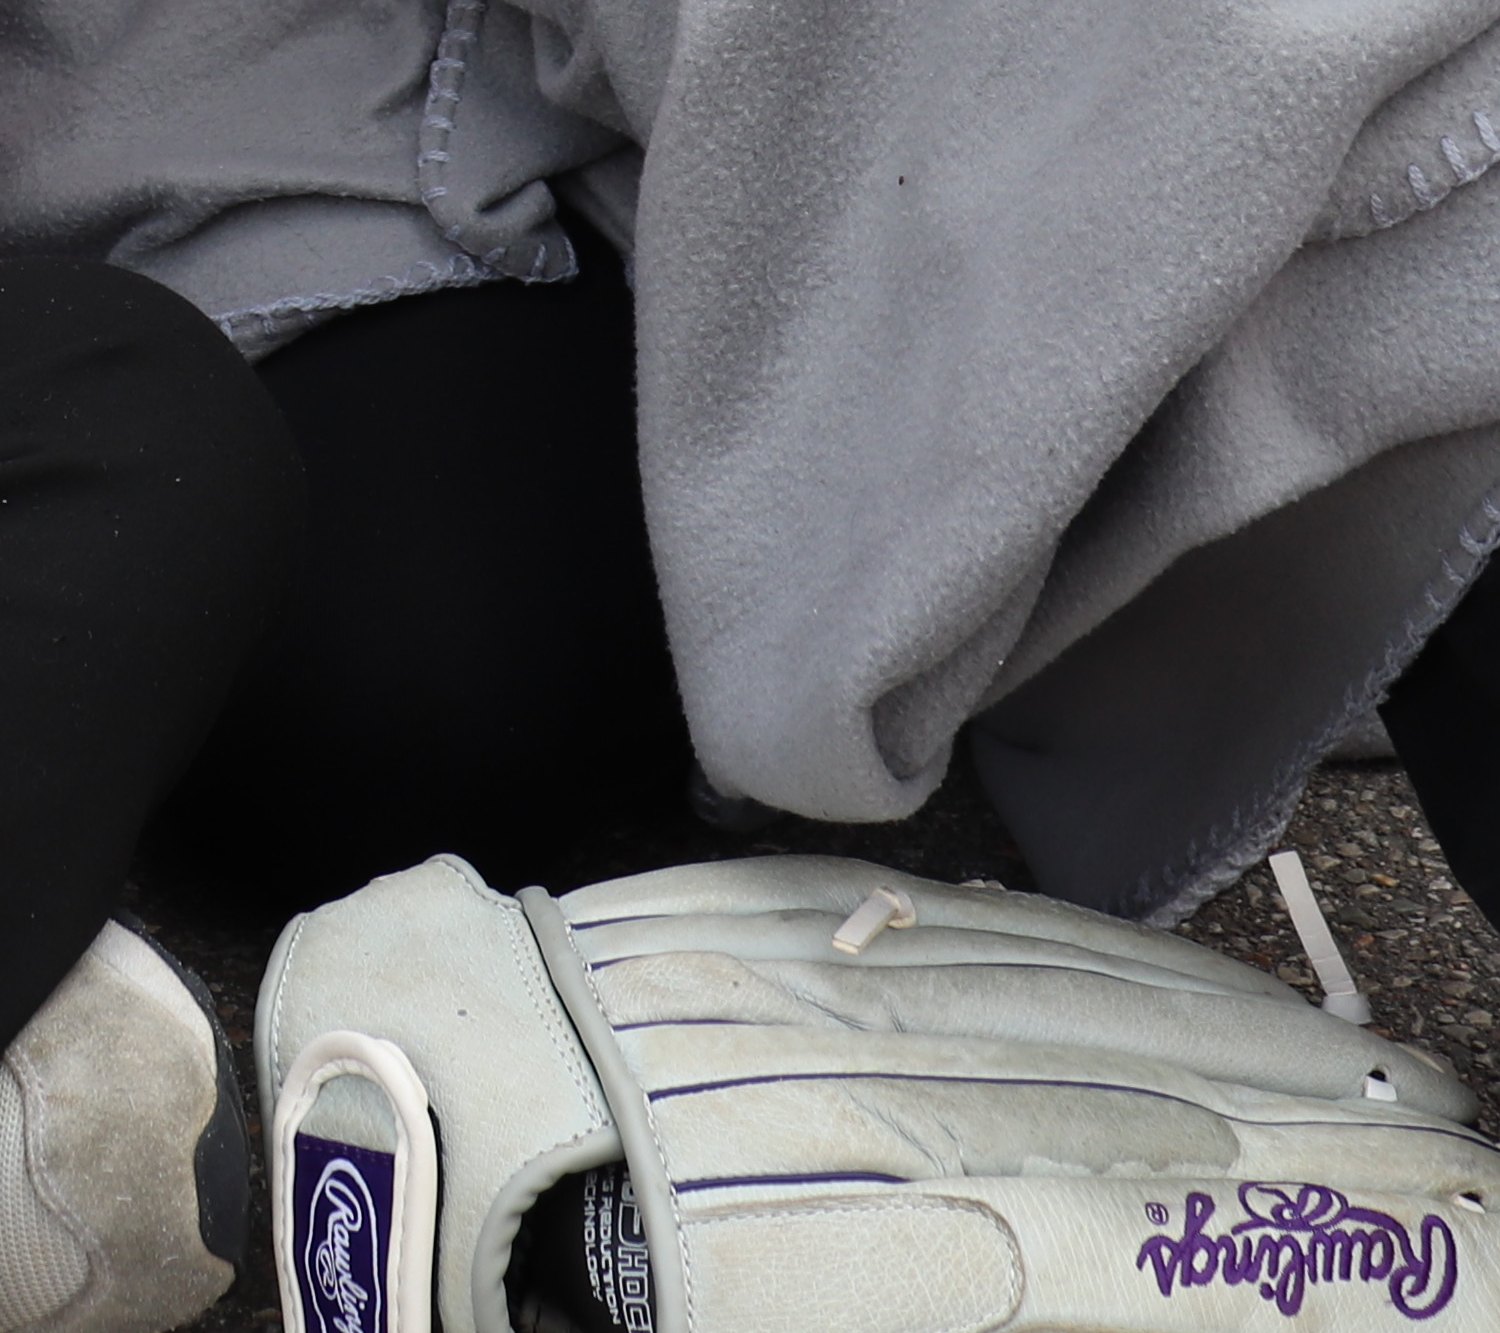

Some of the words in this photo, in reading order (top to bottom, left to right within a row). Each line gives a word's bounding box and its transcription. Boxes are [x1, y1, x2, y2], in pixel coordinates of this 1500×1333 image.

[325, 1178, 369, 1333] Rawling
[618, 1204, 654, 1333] SHOC
[1137, 1192, 1458, 1321] Rawlings
